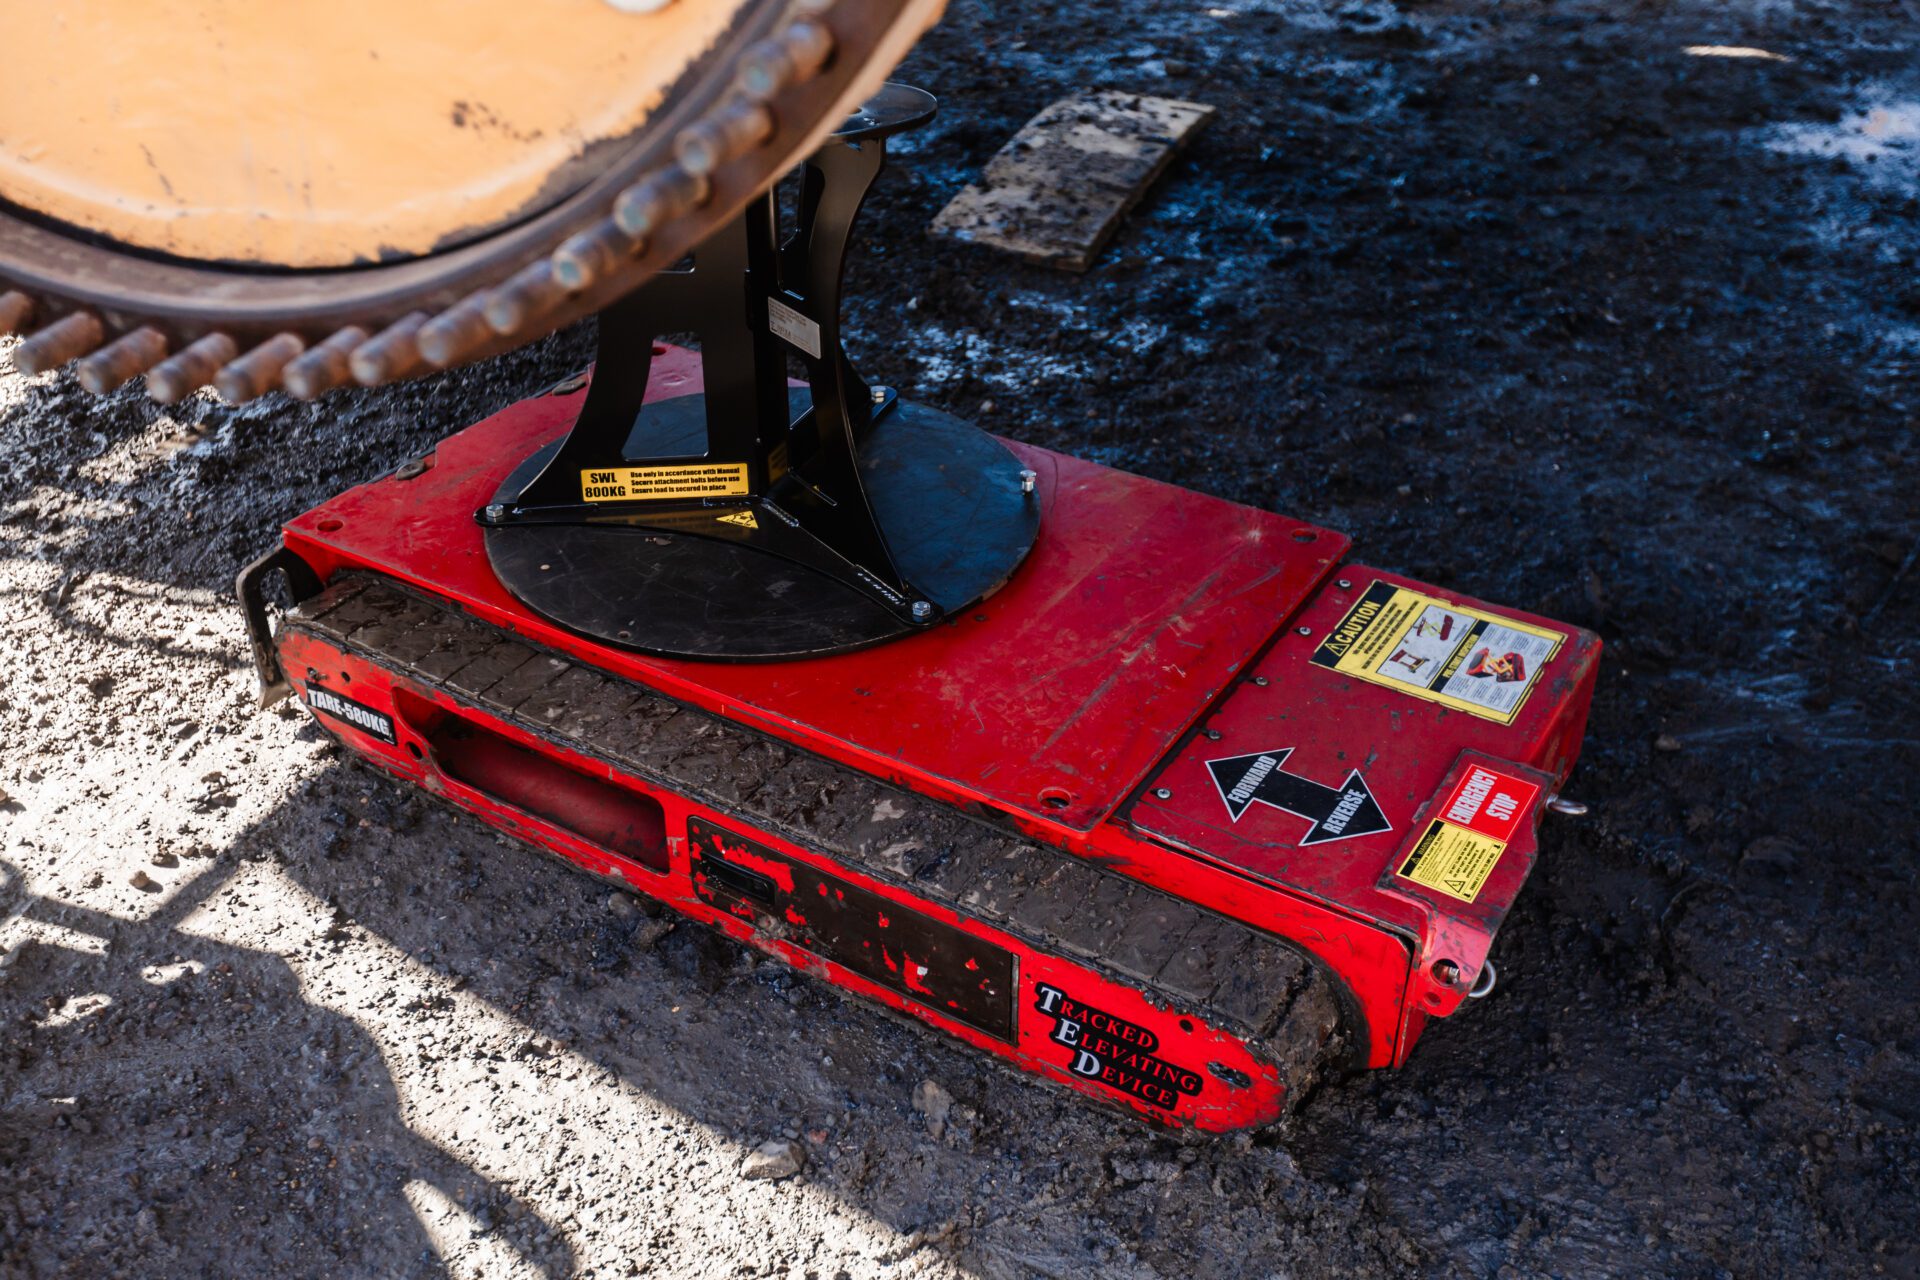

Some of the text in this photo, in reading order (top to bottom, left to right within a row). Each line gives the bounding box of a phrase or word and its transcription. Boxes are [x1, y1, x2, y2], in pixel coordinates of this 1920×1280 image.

[585, 485, 627, 498] 800KG
[590, 471, 618, 484] SWL
[643, 470, 657, 478] only
[665, 469, 702, 477] accordance
[675, 484, 701, 492] secured
[708, 484, 727, 492] place
[1334, 600, 1382, 644] CAUTION
[1226, 755, 1278, 804] FORWARD
[1446, 768, 1498, 825] EMERGENCY
[1321, 788, 1368, 835] REVERSE
[1485, 792, 1519, 821] STOP
[1040, 986, 1154, 1049] TRACKED
[1055, 1017, 1198, 1091] ELEVATING
[1073, 1049, 1174, 1105] DEVICE
